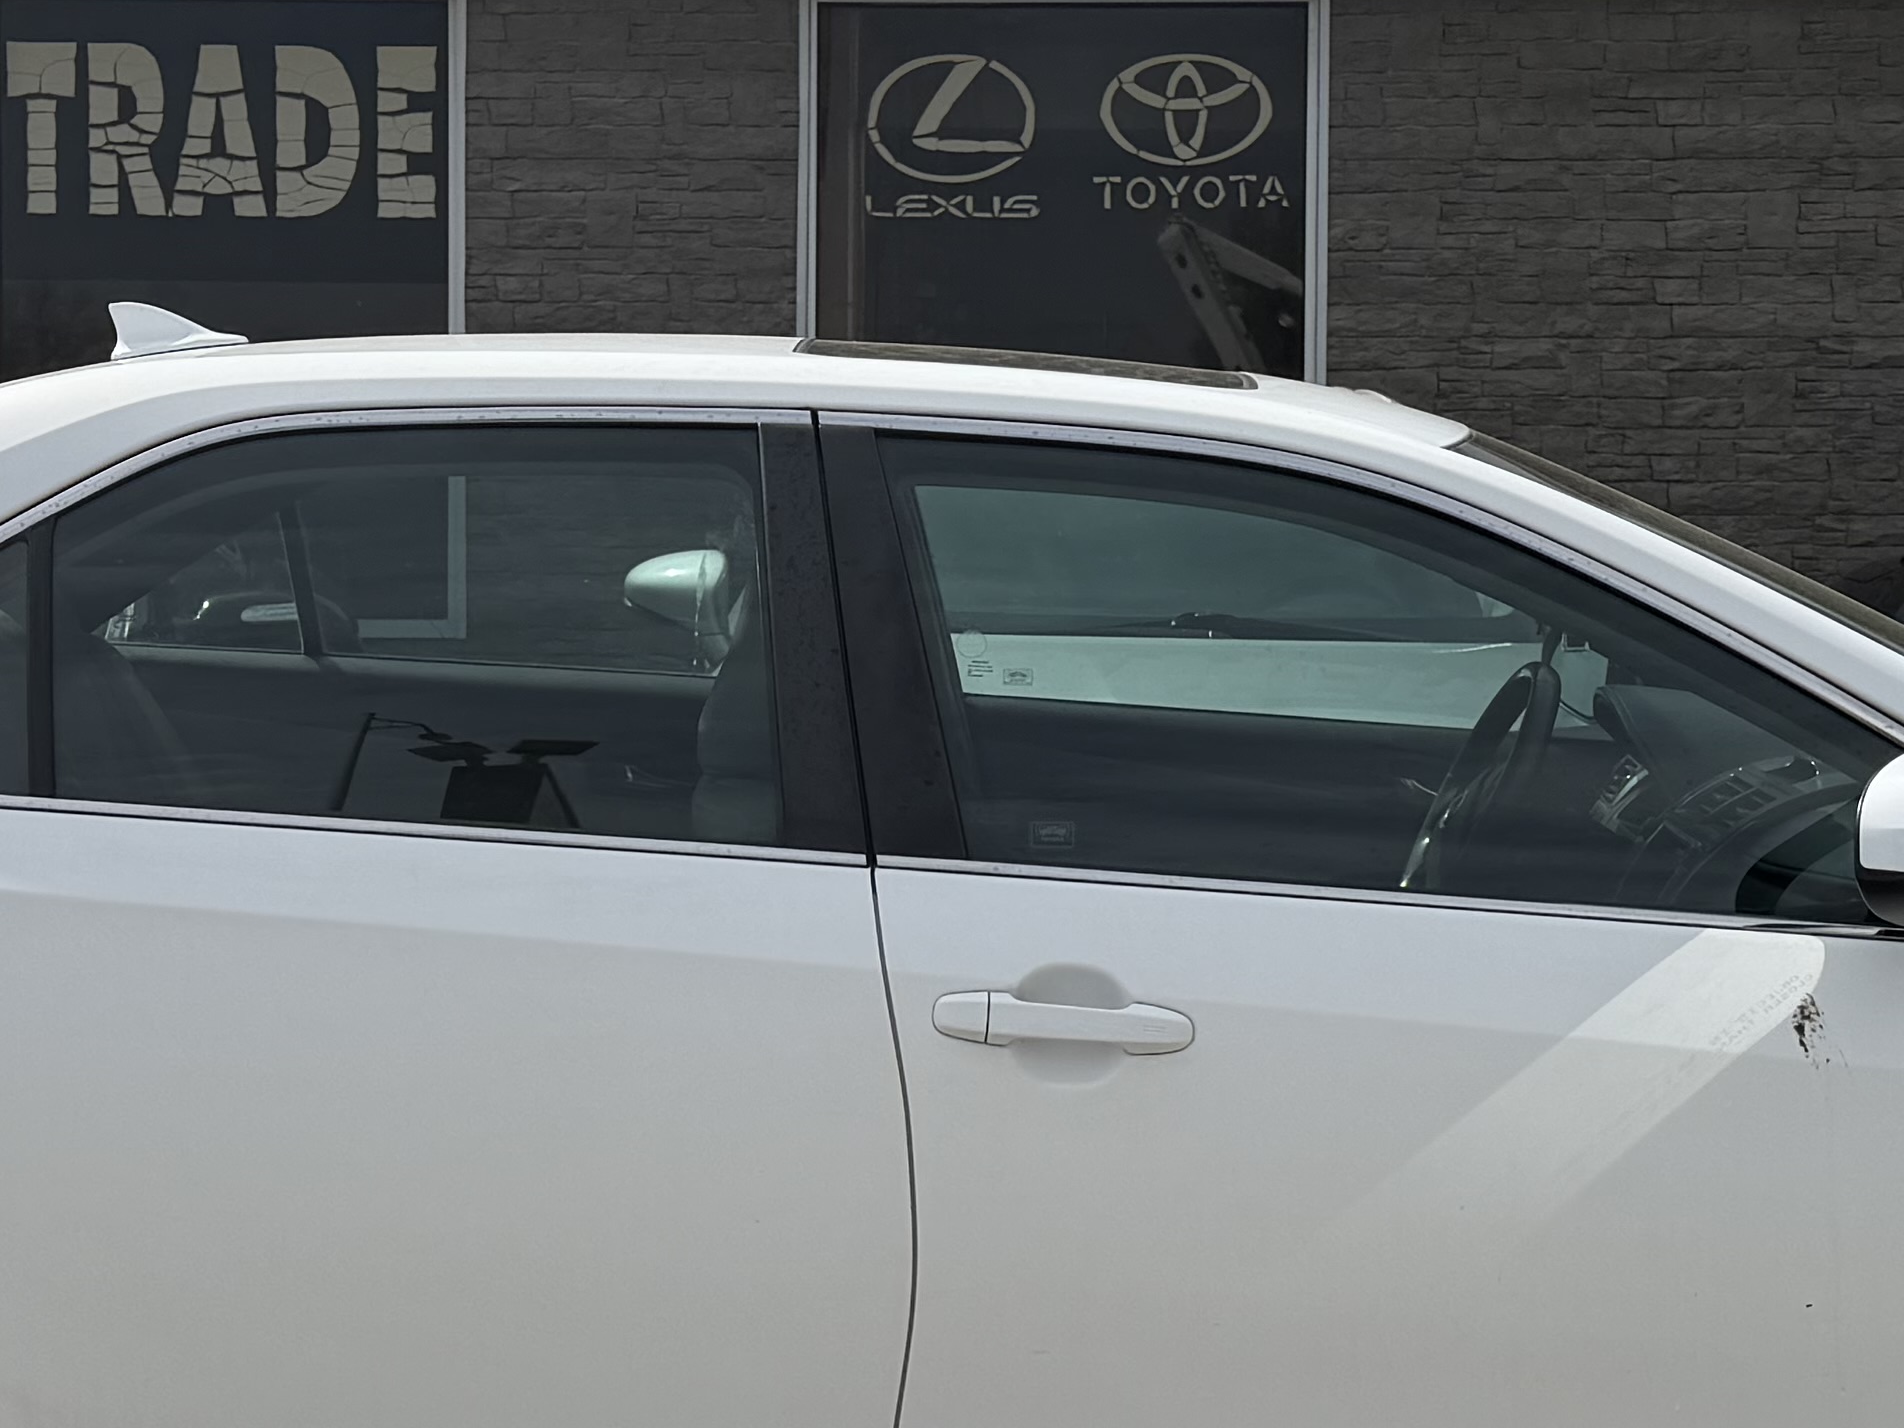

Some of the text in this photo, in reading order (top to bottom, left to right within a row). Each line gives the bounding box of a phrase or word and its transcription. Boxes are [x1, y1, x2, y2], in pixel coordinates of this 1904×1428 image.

[6, 41, 438, 220] TRADE
[864, 194, 1041, 219] LEXUS
[1092, 174, 1290, 210] TOYOTA
